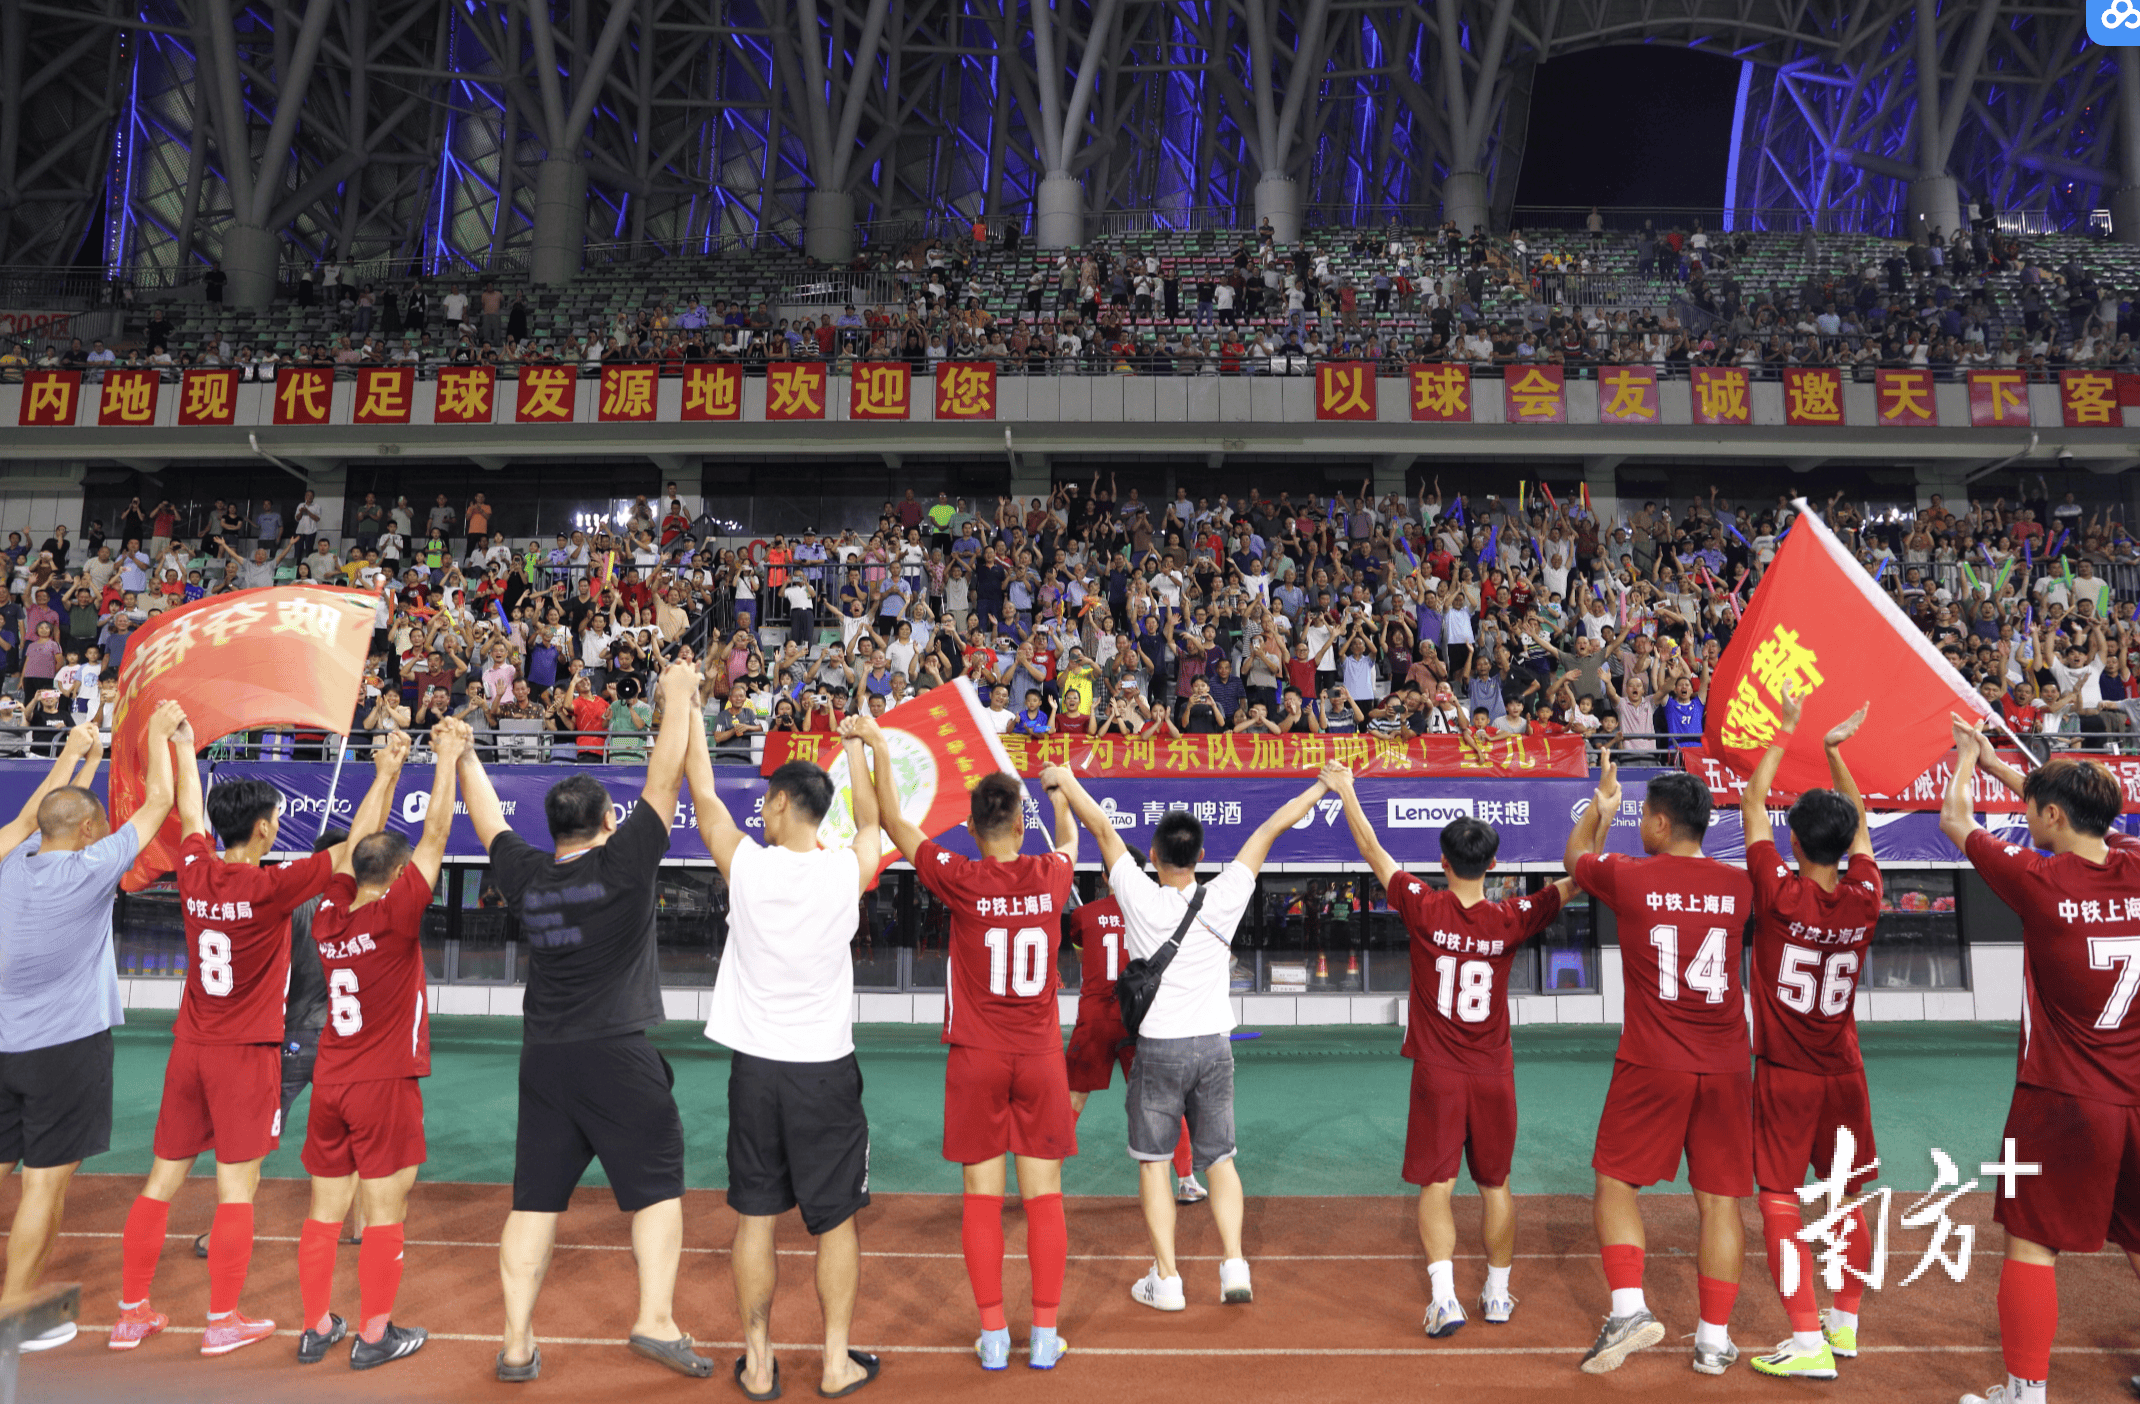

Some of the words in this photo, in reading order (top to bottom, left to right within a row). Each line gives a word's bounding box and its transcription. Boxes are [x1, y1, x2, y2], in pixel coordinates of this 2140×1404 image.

[26, 366, 991, 422] 内地现代足球发源地欢迎您
[1322, 367, 2117, 423] 以球会友诚邀天下客
[1395, 804, 1466, 820] Lenovo
[1478, 801, 1530, 825] 联想
[186, 897, 253, 922] 中铁上海局
[976, 893, 1053, 917] 中铁上海局
[1646, 891, 1735, 915] 中铁上海局
[1102, 933, 1127, 981] 1
[1433, 929, 1504, 956] 中铁上海局
[1788, 921, 1867, 945] 中铁上海局
[198, 929, 234, 996] 8
[984, 927, 1048, 997] 10
[1435, 955, 1494, 1023] 18
[1650, 924, 1729, 1004] 14
[1777, 943, 1859, 1016] 56
[2086, 935, 2140, 1029] 7
[329, 968, 362, 1036] 6
